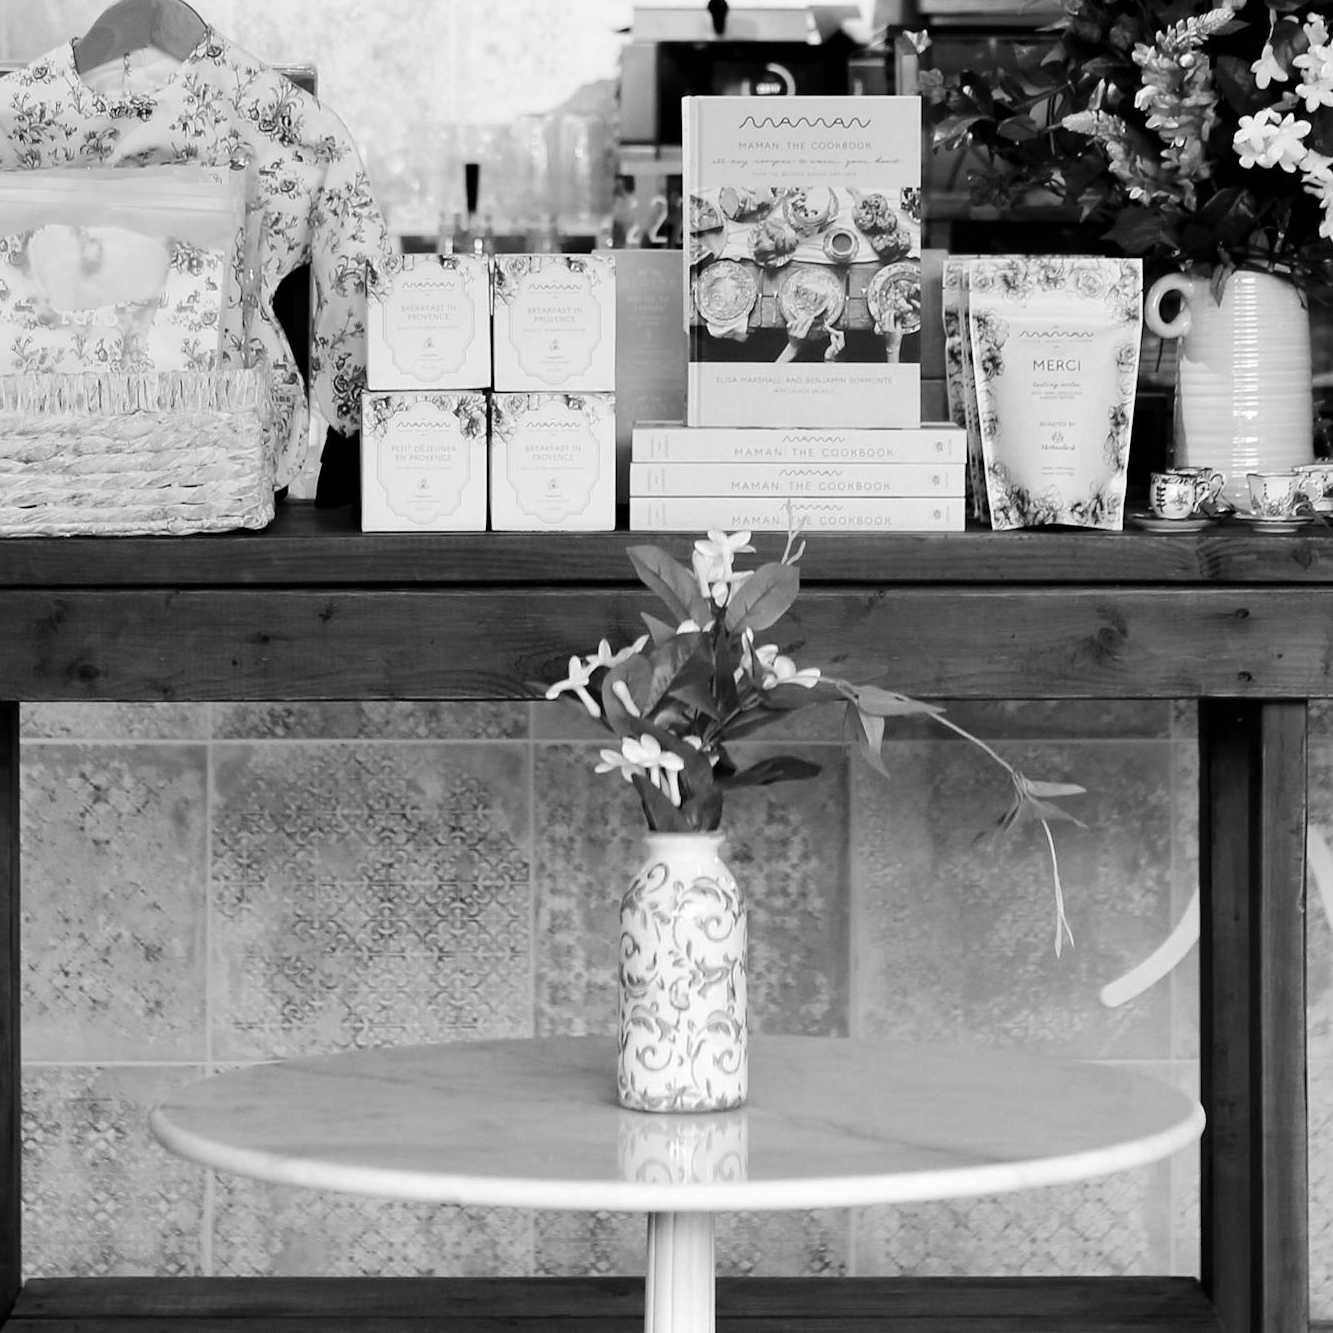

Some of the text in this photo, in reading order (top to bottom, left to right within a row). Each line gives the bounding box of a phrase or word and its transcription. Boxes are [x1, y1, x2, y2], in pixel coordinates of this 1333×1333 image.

[787, 141, 805, 151] THE
[810, 141, 872, 151] COOKBOOK
[400, 304, 444, 312] BREAKFAST
[407, 313, 450, 321] PROVENCE
[1033, 359, 1082, 372] MERCI
[740, 376, 782, 385] MARSHALL
[785, 376, 803, 385] AND
[525, 444, 570, 452] BREAKFAST
[792, 447, 815, 458] THE
[821, 447, 894, 458] COOKBOOK
[409, 454, 452, 462] PROVENCE
[532, 454, 575, 462] PROVENCE
[788, 481, 812, 492] THE
[818, 481, 891, 492] COOKBOOK
[818, 515, 892, 526] COOKBOOK
